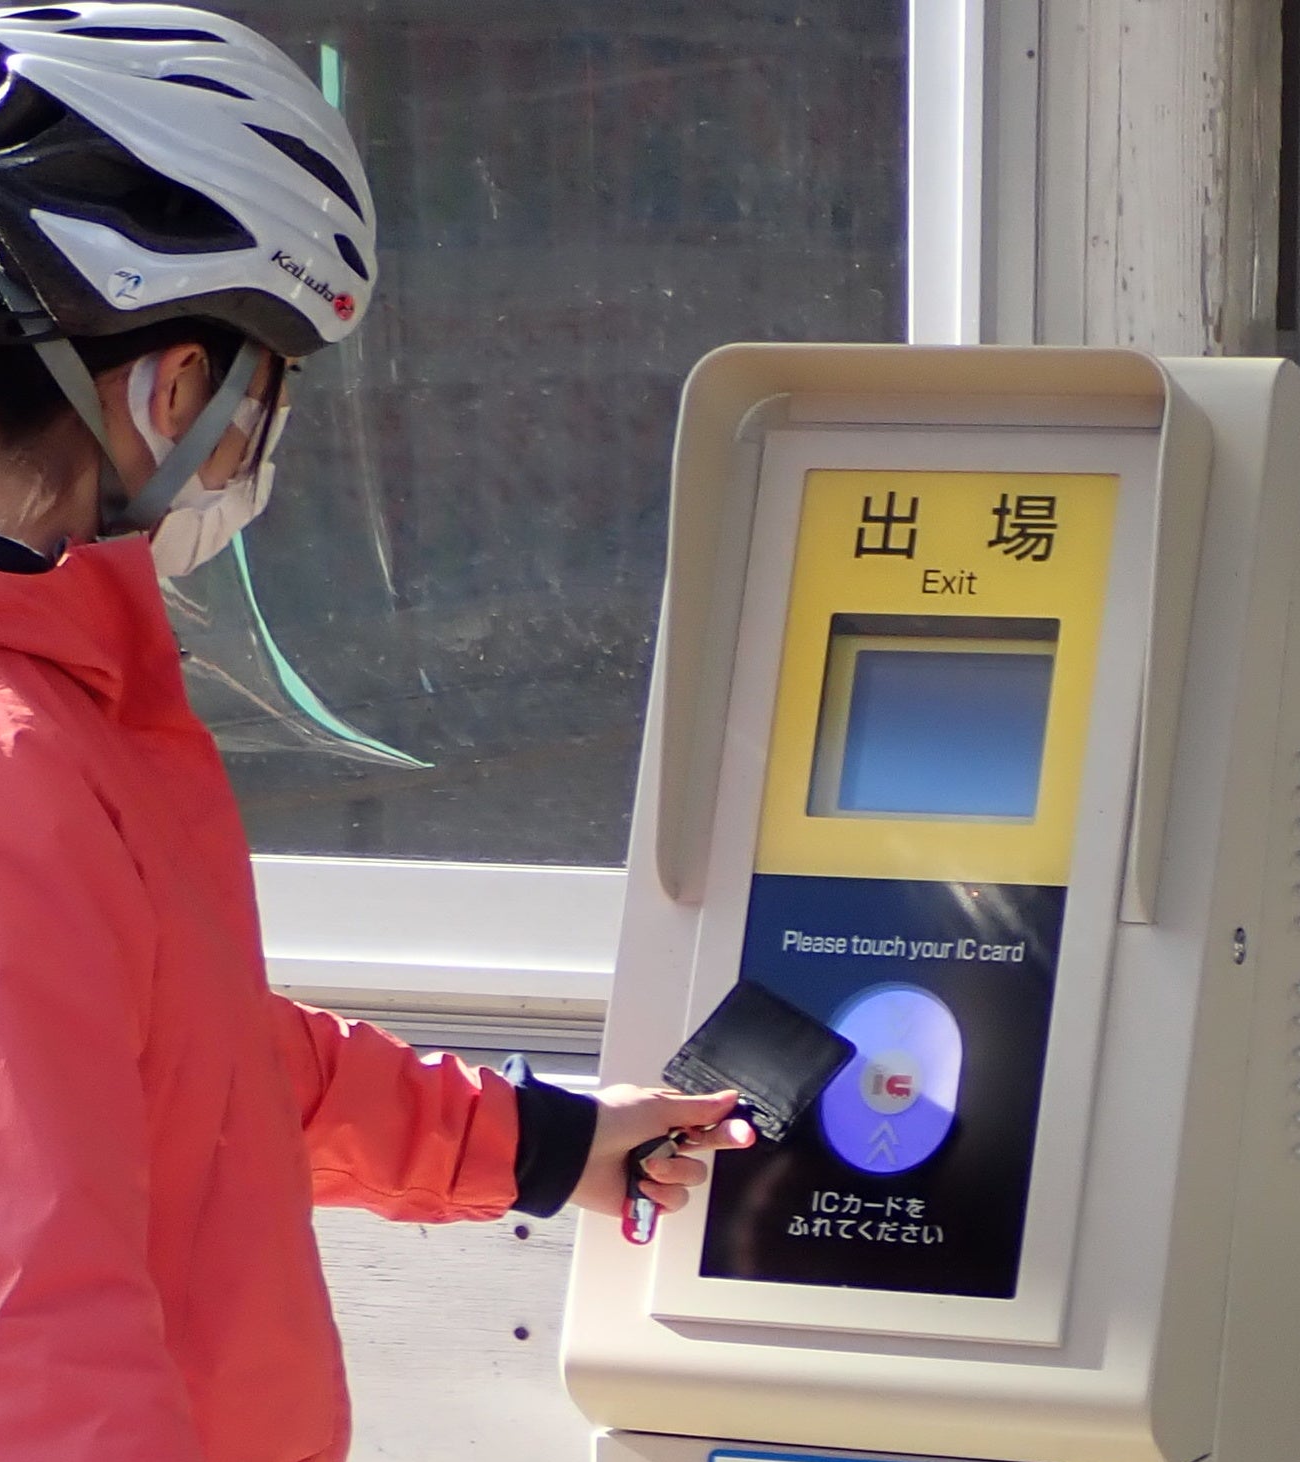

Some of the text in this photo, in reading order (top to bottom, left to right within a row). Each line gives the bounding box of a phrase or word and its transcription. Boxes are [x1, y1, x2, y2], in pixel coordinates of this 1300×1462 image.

[922, 569, 978, 595] Exit
[782, 930, 1025, 962] Please touch your IC card
[811, 1190, 926, 1219] ICカードを
[787, 1215, 944, 1244] ふれてください
